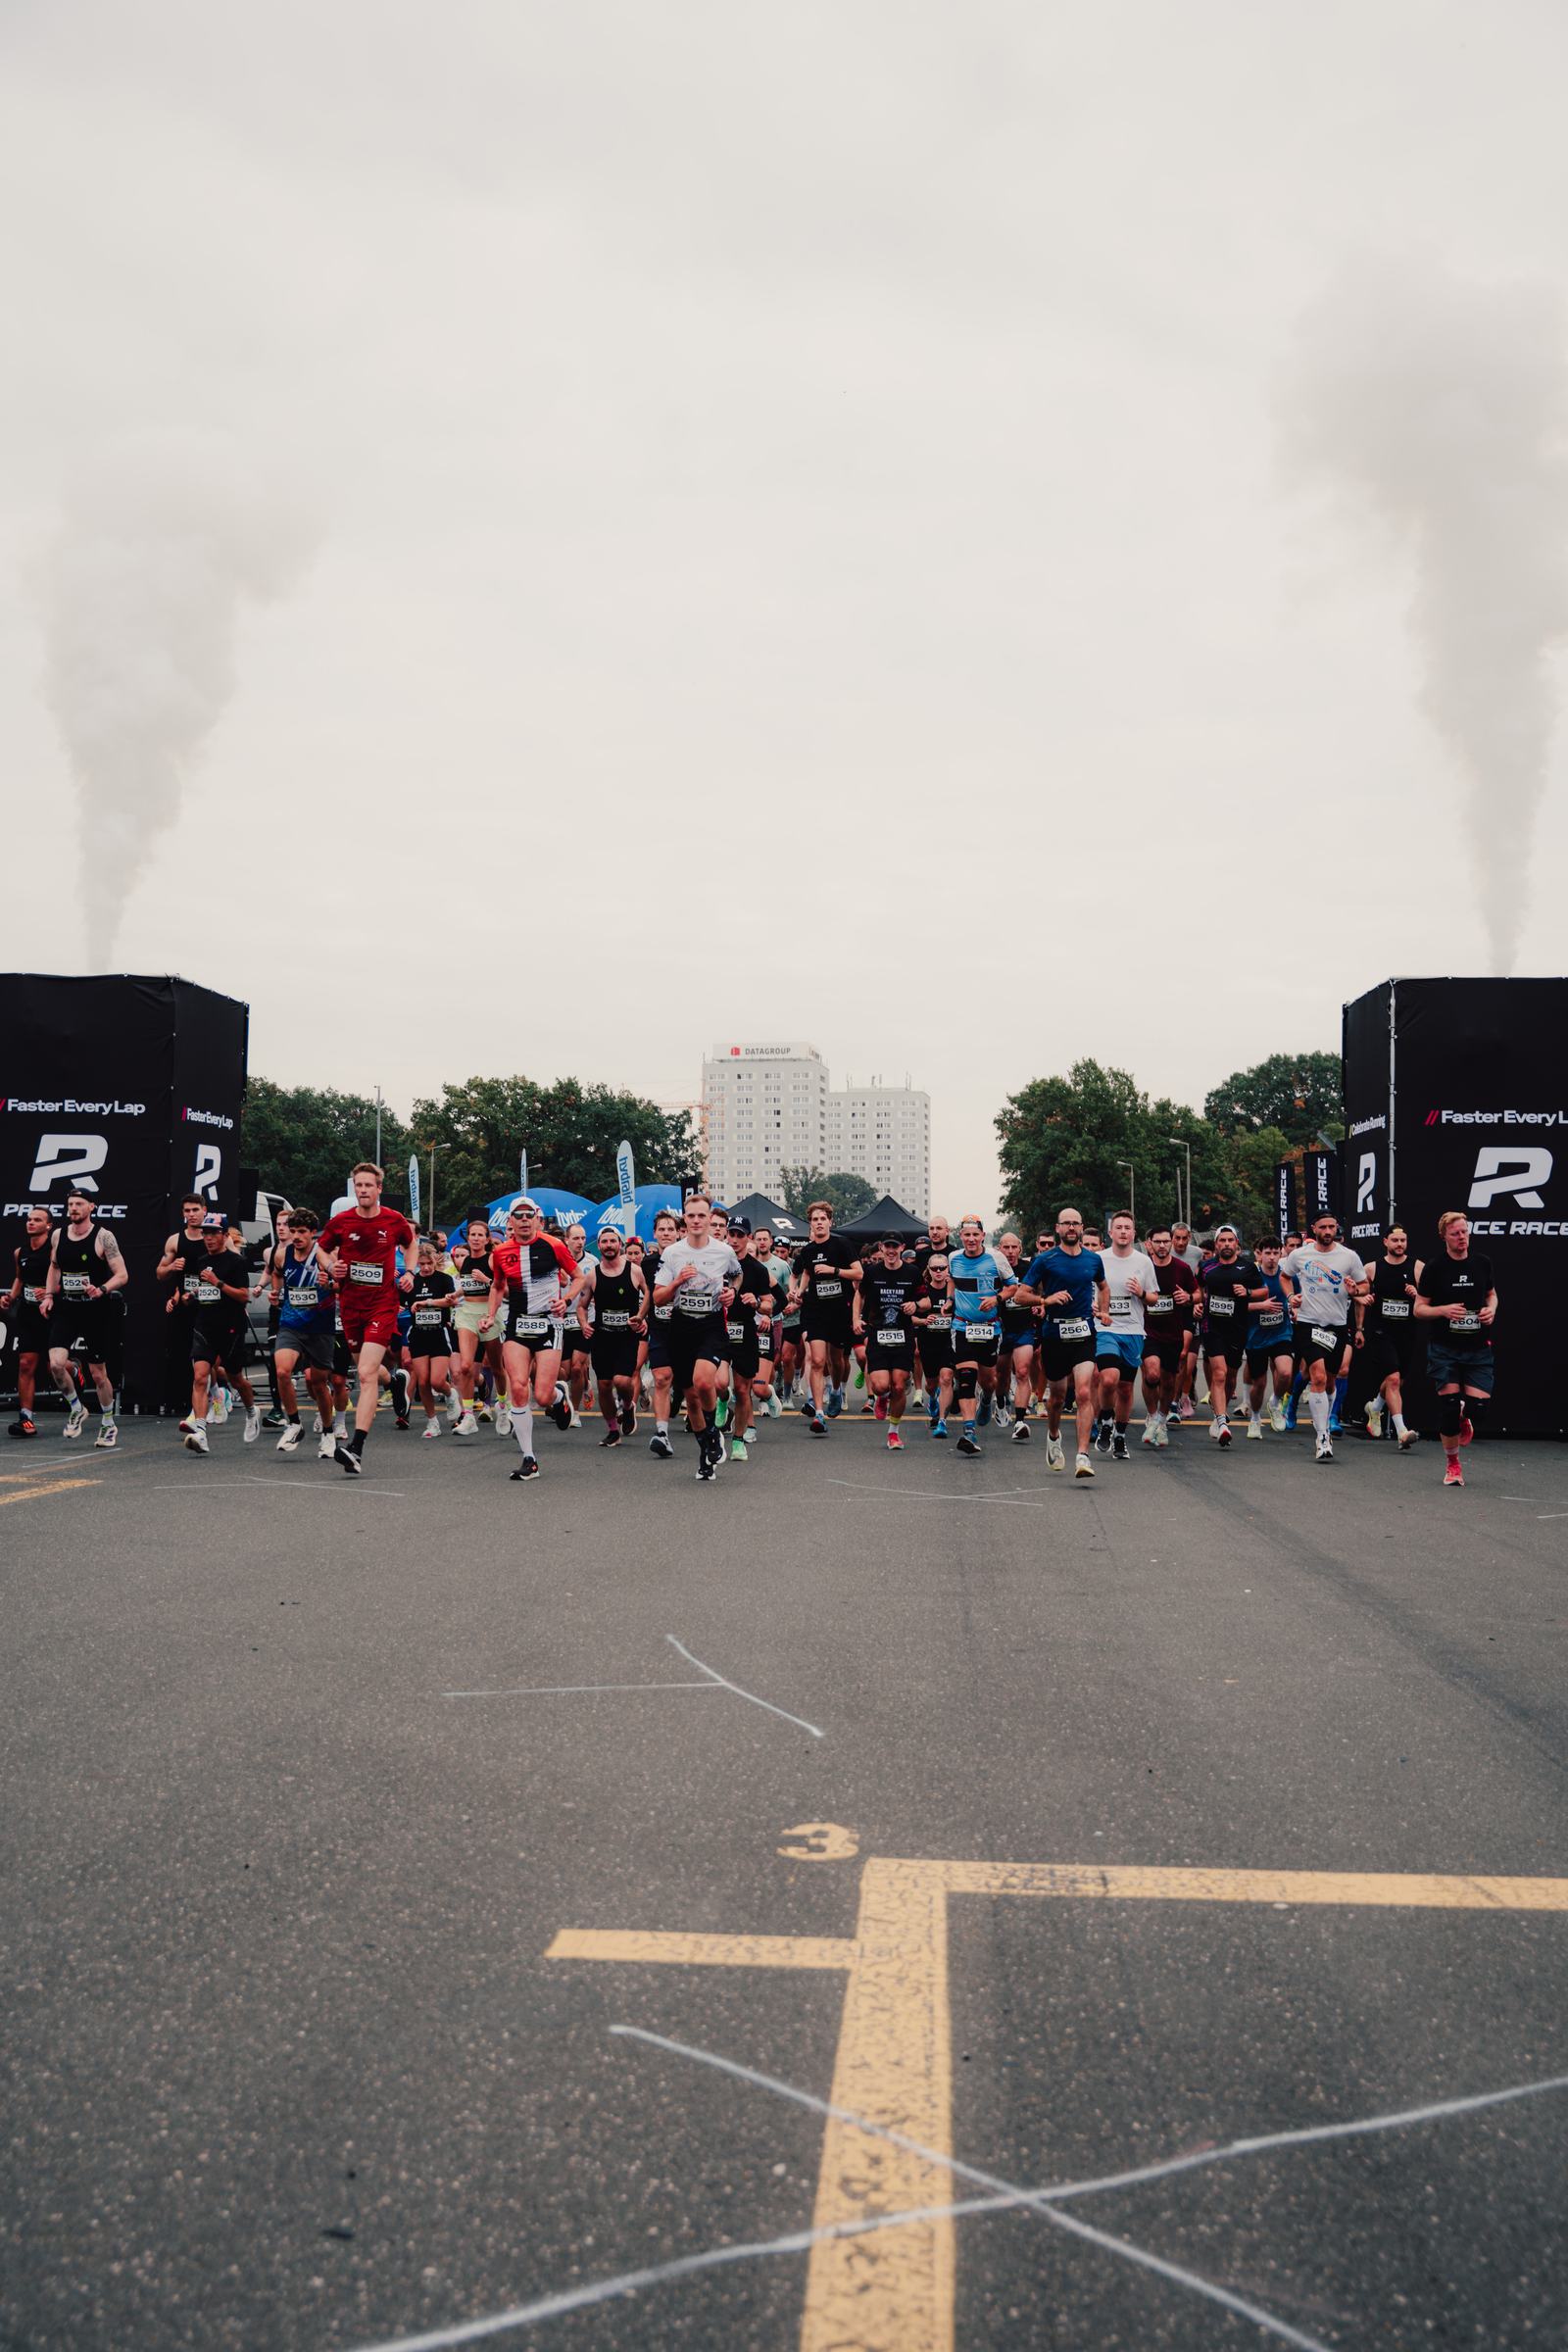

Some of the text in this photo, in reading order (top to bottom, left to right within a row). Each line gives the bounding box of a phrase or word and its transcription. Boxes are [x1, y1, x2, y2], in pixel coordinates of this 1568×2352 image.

[7, 1099, 146, 1115] Faster Every Lap
[187, 1107, 233, 1130] Faster Every Lap
[1441, 1109, 1502, 1124] Faster
[1503, 1109, 1556, 1126] Every
[1351, 1114, 1386, 1136] Celebrate Running
[619, 1156, 634, 1204] hydraid
[1317, 1157, 1328, 1205] RACE
[1351, 1223, 1380, 1239] PACE RACE
[351, 1268, 381, 1279] 2509
[64, 1278, 88, 1287] 252
[289, 1294, 317, 1302] 2530
[680, 1298, 710, 1308] 2591
[1210, 1301, 1233, 1310] 2595
[1384, 1304, 1407, 1313] 2579
[416, 1313, 441, 1322] 2583
[517, 1321, 546, 1330] 2588
[1060, 1325, 1089, 1335] 2560
[776, 1822, 860, 1862] 3
